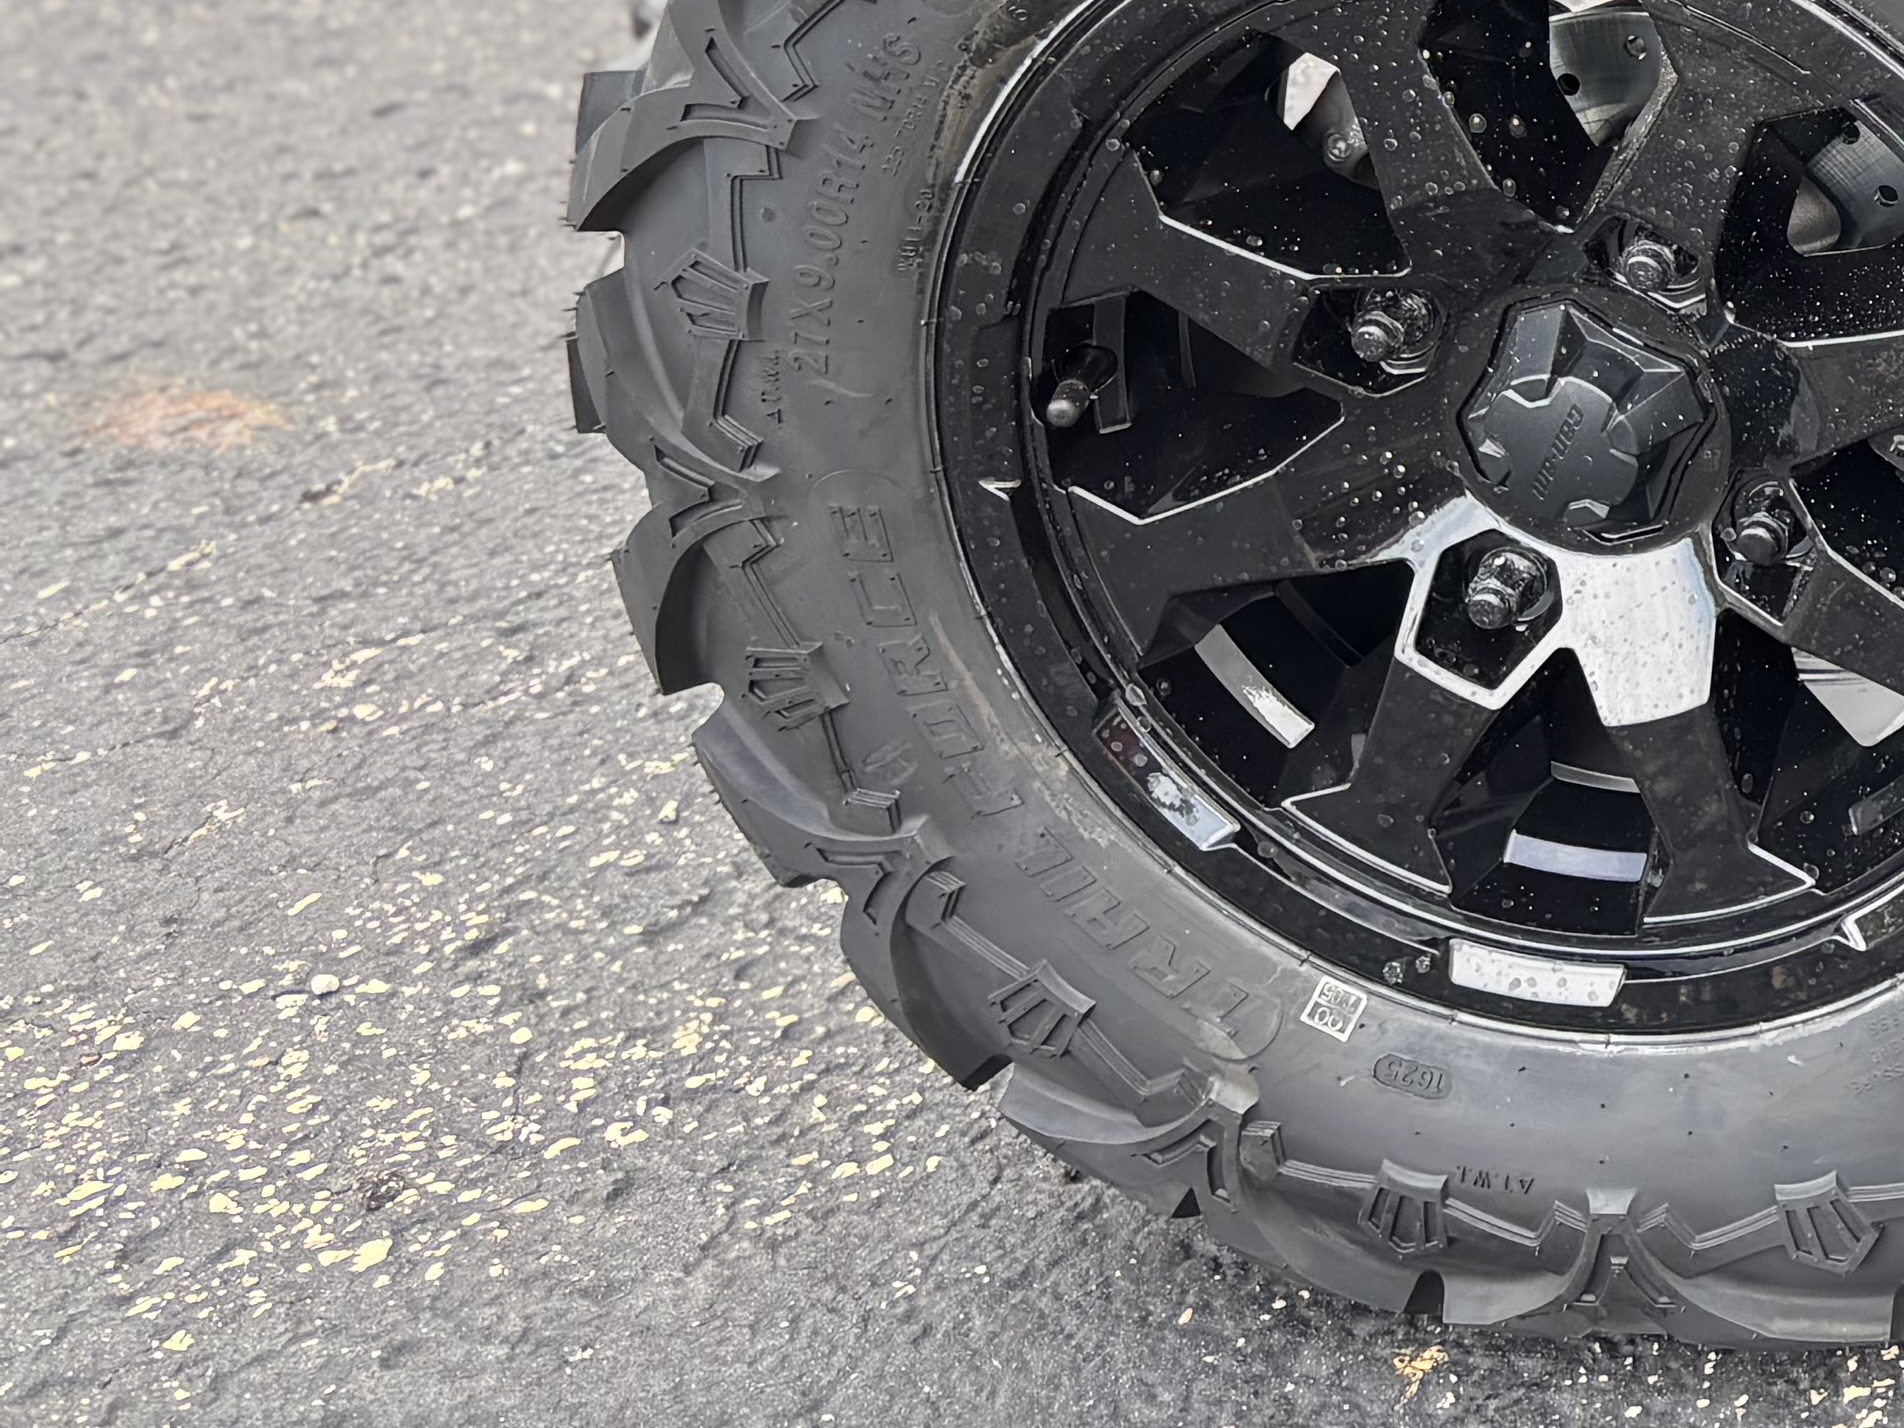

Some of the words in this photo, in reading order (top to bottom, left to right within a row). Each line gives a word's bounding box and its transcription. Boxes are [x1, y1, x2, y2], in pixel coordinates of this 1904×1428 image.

[789, 126, 875, 371] 27X9.00R14
[844, 28, 924, 121] NHS
[819, 497, 1023, 819] FORCE
[1014, 816, 1253, 1047] TRAIL
